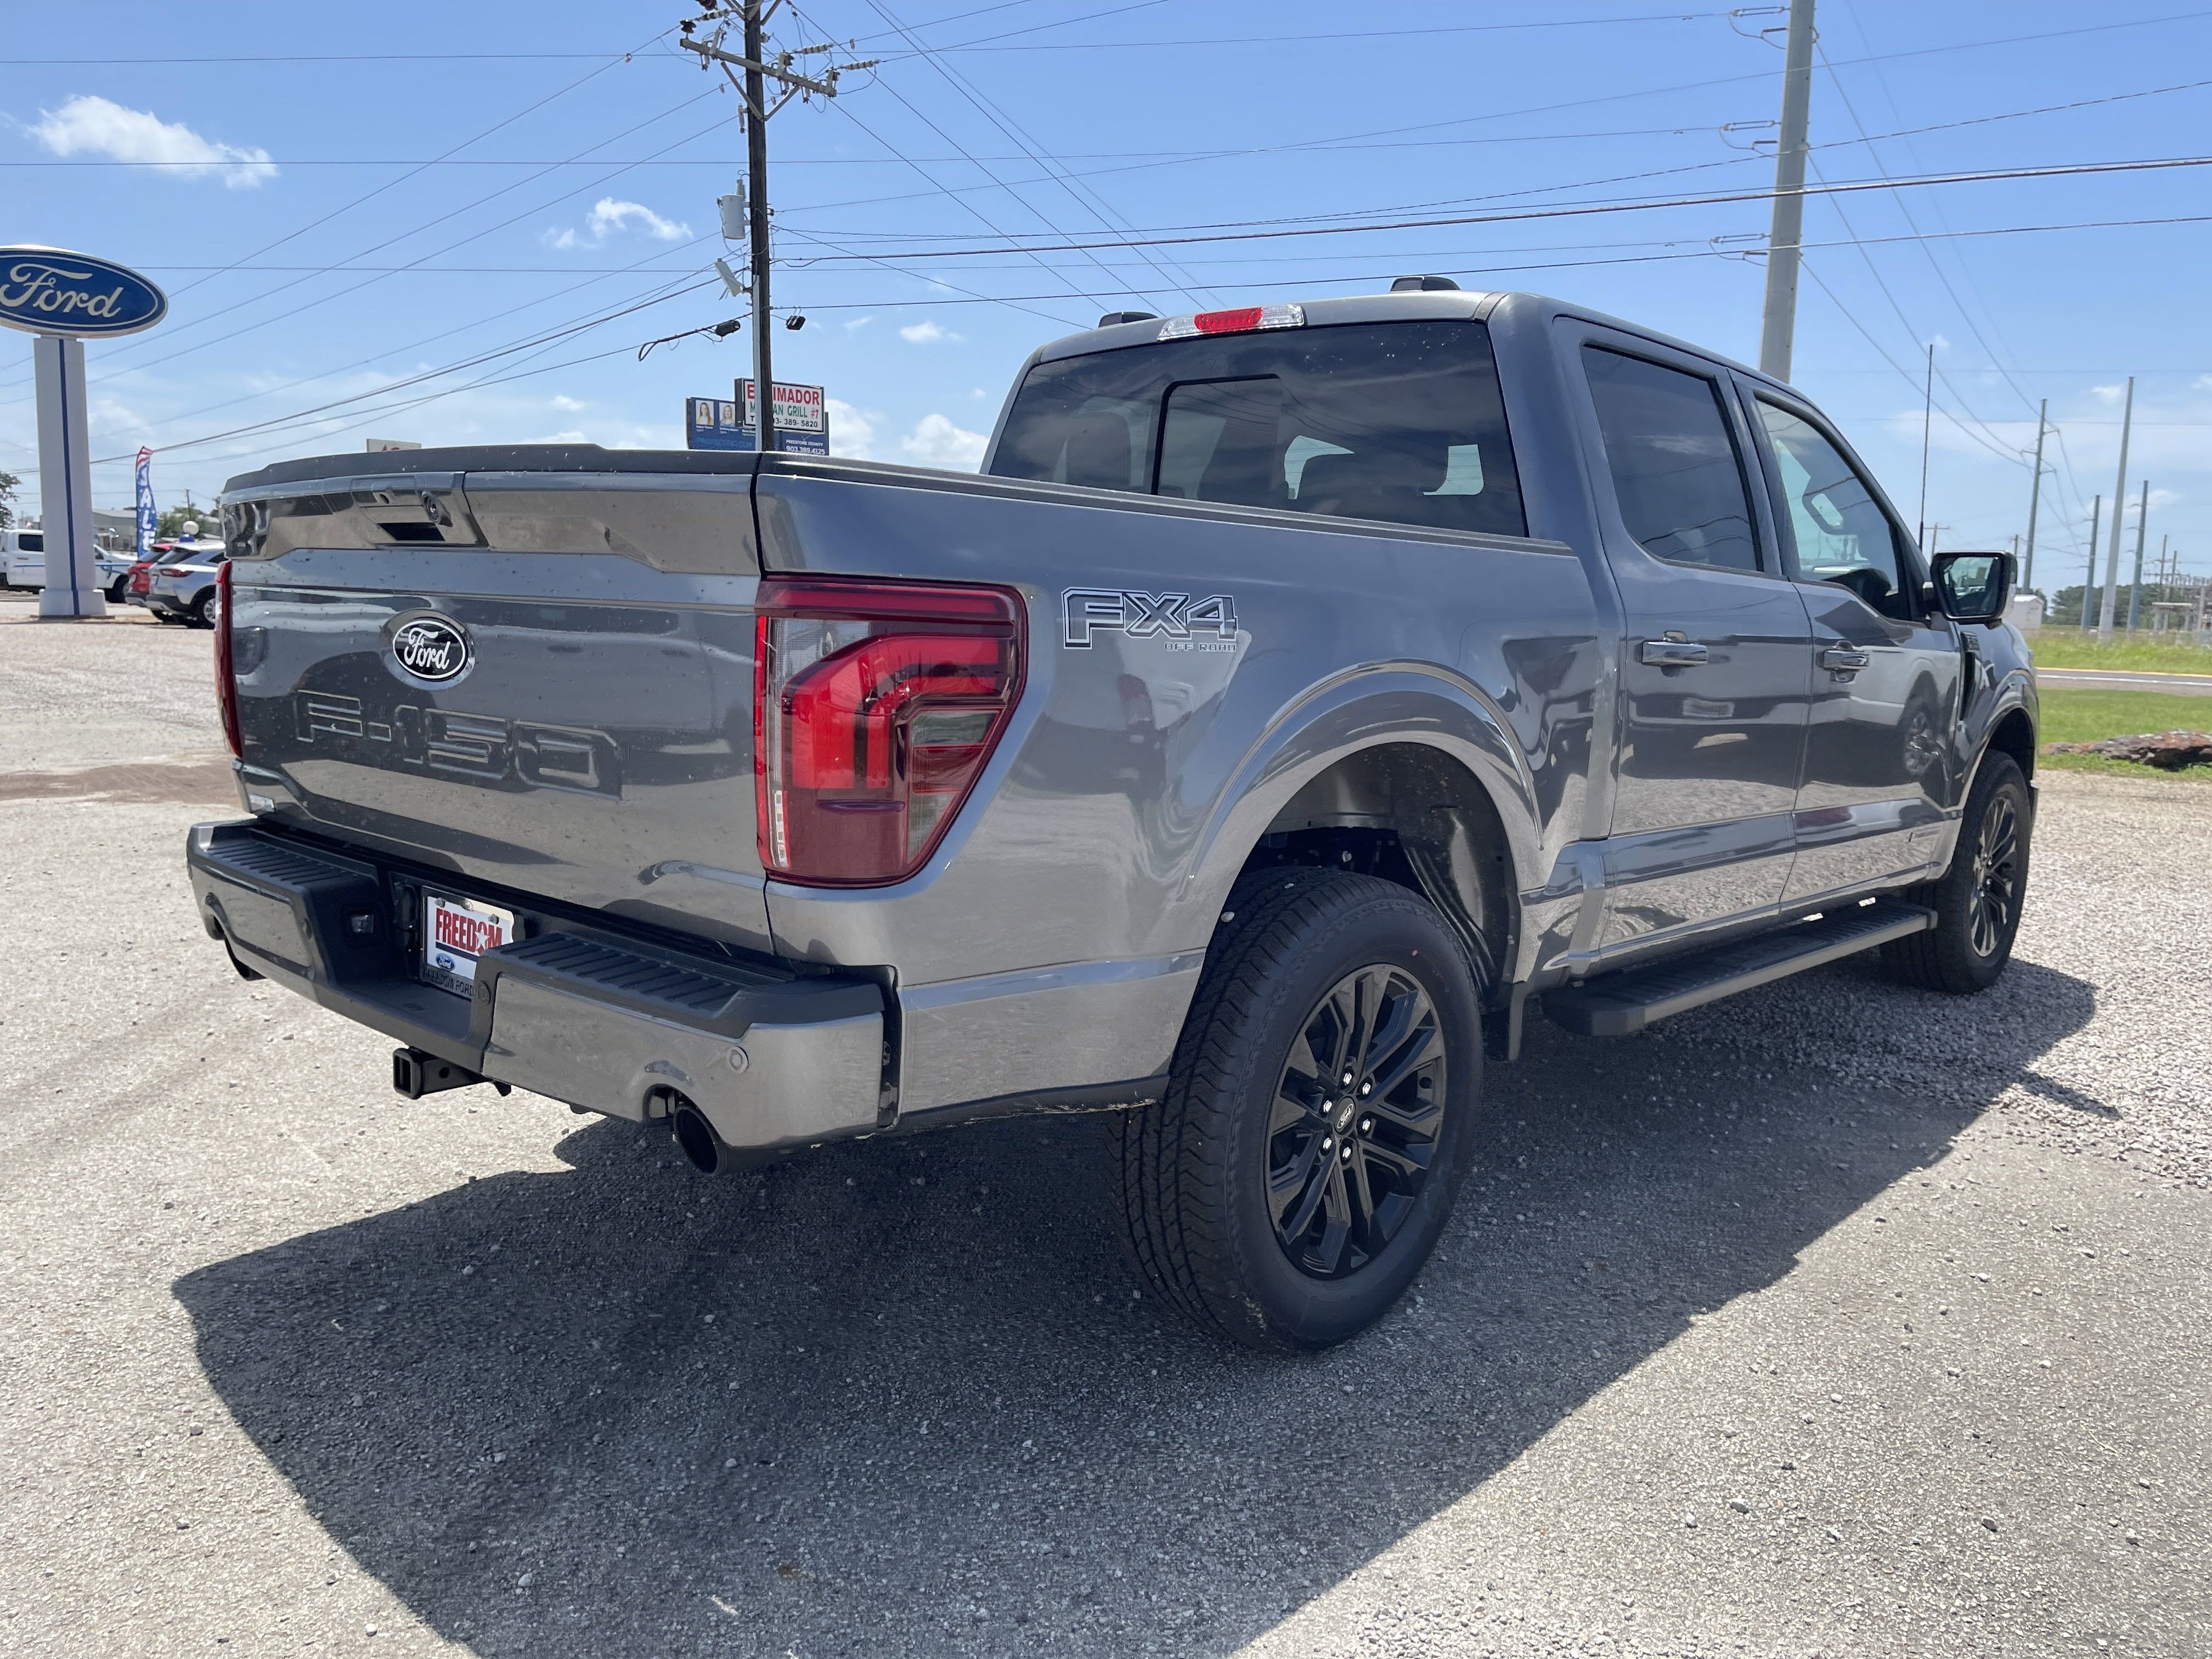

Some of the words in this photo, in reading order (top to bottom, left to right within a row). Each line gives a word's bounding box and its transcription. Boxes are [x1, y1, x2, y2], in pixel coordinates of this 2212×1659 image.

[0, 263, 123, 318] Ford
[773, 387, 820, 405] IMADOR
[787, 405, 808, 417] GRILL
[811, 408, 819, 419] #7
[139, 467, 155, 551] SALE
[1061, 586, 1239, 650] FX4
[404, 627, 451, 670] Ford
[1164, 642, 1194, 652] OFF
[1198, 642, 1238, 653] ROAD
[292, 689, 623, 799] F-150
[436, 907, 503, 955] FREEDOM
